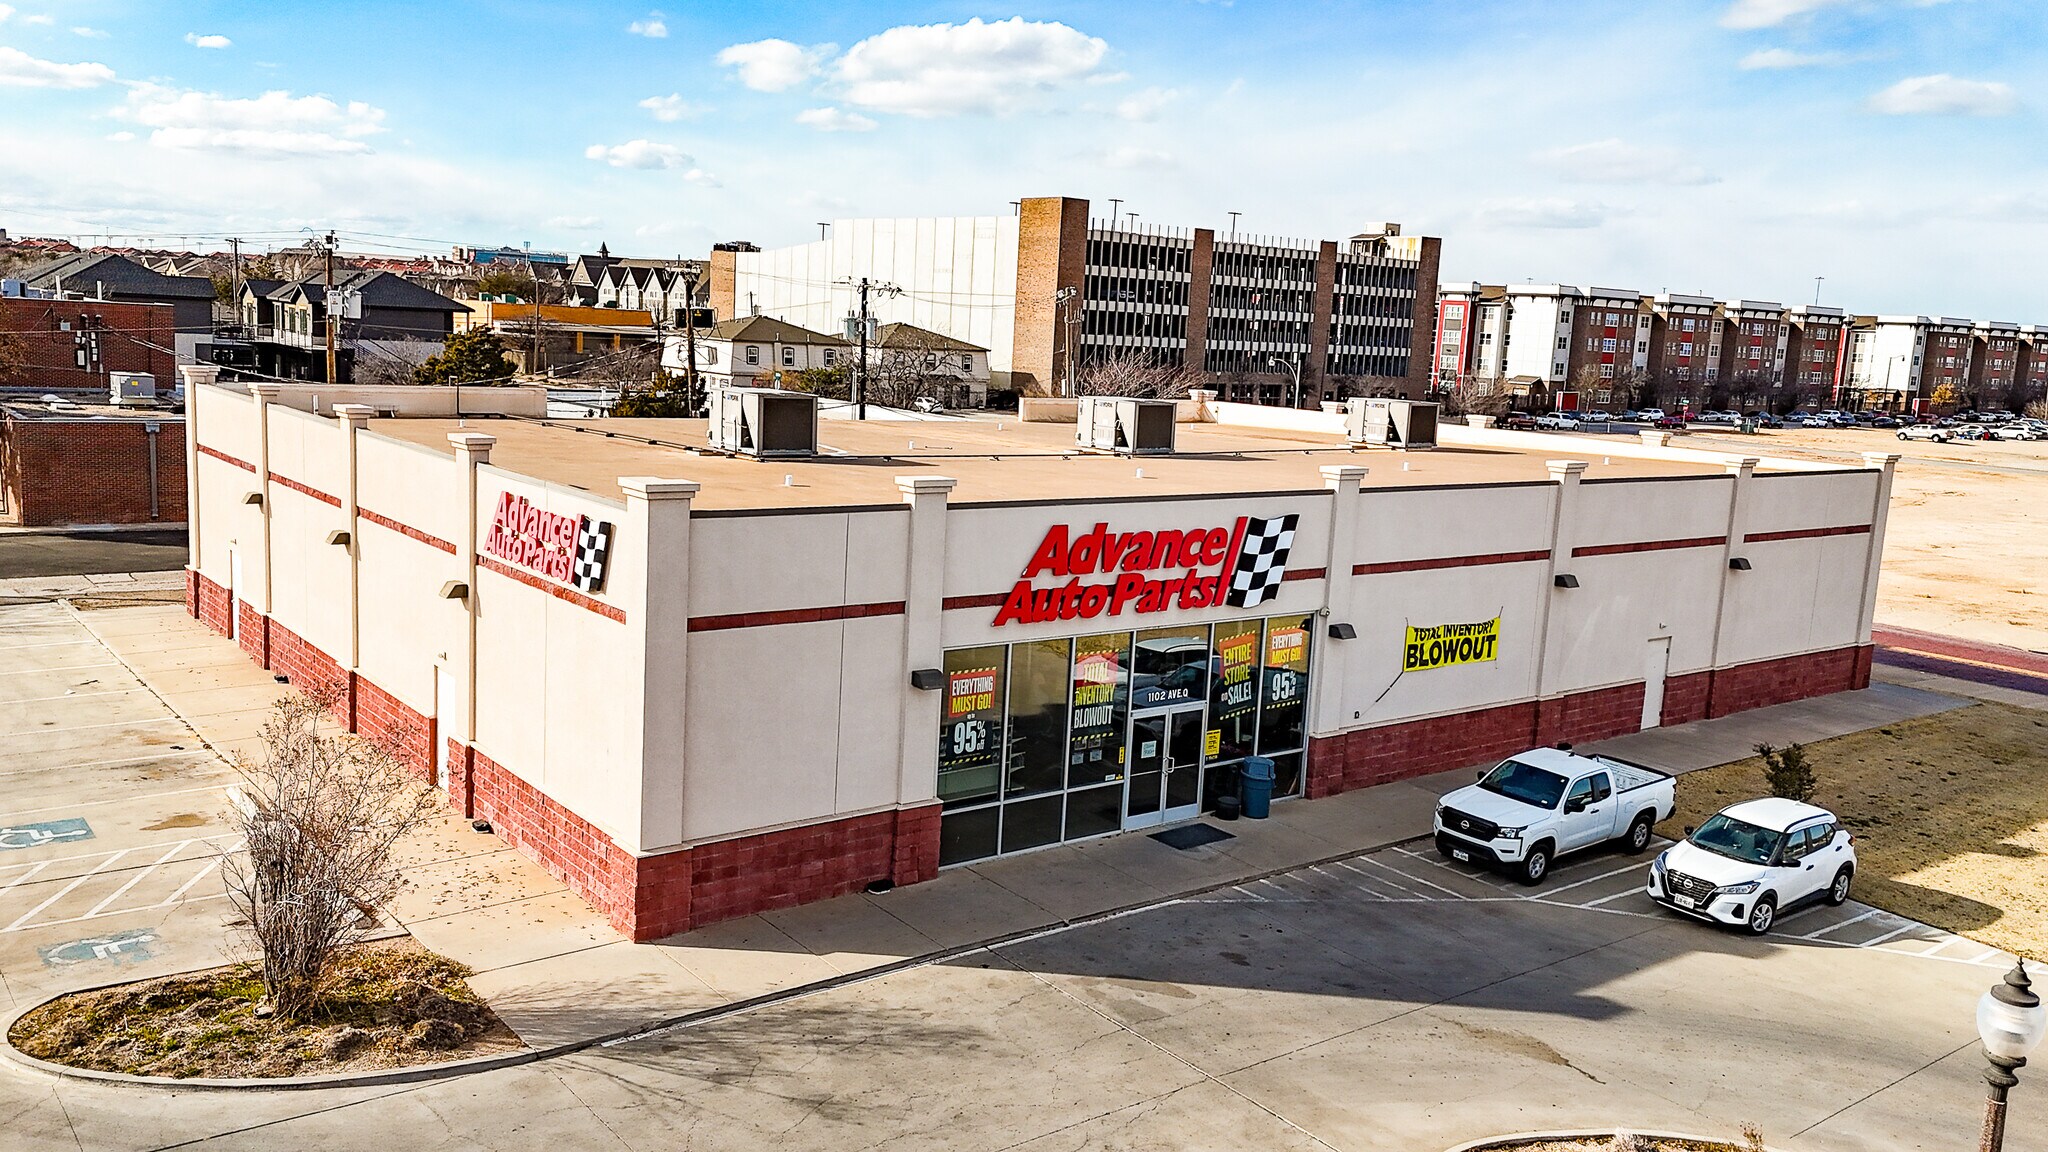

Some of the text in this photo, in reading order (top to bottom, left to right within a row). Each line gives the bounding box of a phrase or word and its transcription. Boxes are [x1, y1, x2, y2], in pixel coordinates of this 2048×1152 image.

[493, 490, 575, 548] Advance
[484, 524, 569, 581] Auto Parts
[1021, 522, 1229, 578] Advance
[991, 569, 1218, 627] Auto Parts
[1414, 620, 1495, 642] TOTAL INVENTORY
[1223, 642, 1252, 667] ENTIRE
[1406, 634, 1496, 668] BLOWOUT
[1083, 661, 1109, 683] TOTAL
[1224, 662, 1251, 686] STORE
[952, 676, 994, 697] EVERYTHING
[1148, 691, 1166, 702] 1102
[1228, 681, 1252, 705] SALE!
[952, 693, 992, 713] MUST GO!
[1073, 705, 1113, 729] BLOWOUT
